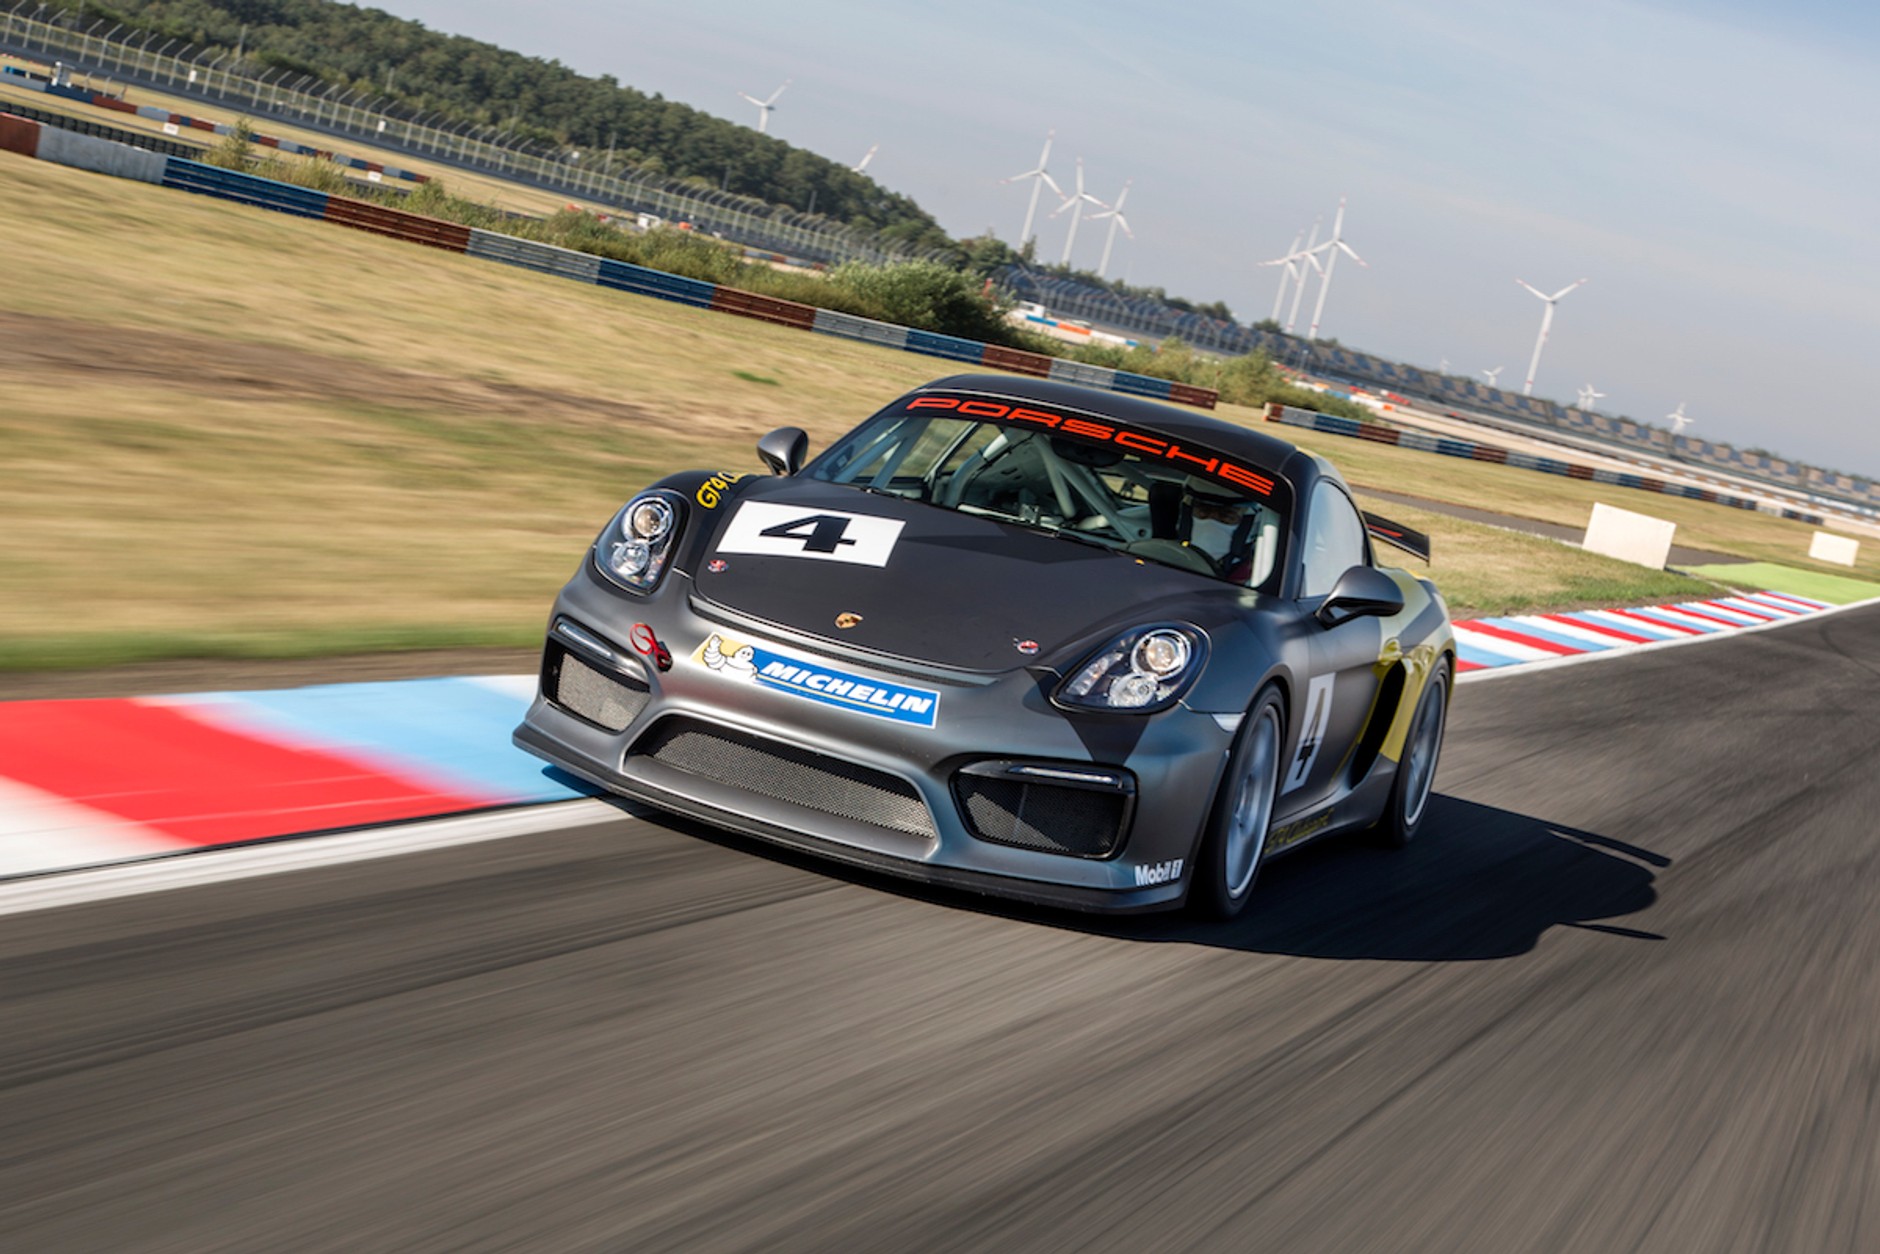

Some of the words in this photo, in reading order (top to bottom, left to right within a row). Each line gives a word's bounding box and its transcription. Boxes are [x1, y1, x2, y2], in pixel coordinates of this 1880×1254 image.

[905, 397, 1275, 497] PORSCHE
[758, 514, 857, 554] 4
[760, 661, 932, 713] MICHELIN
[1295, 687, 1326, 781] 4
[1134, 861, 1172, 886] Mobil
